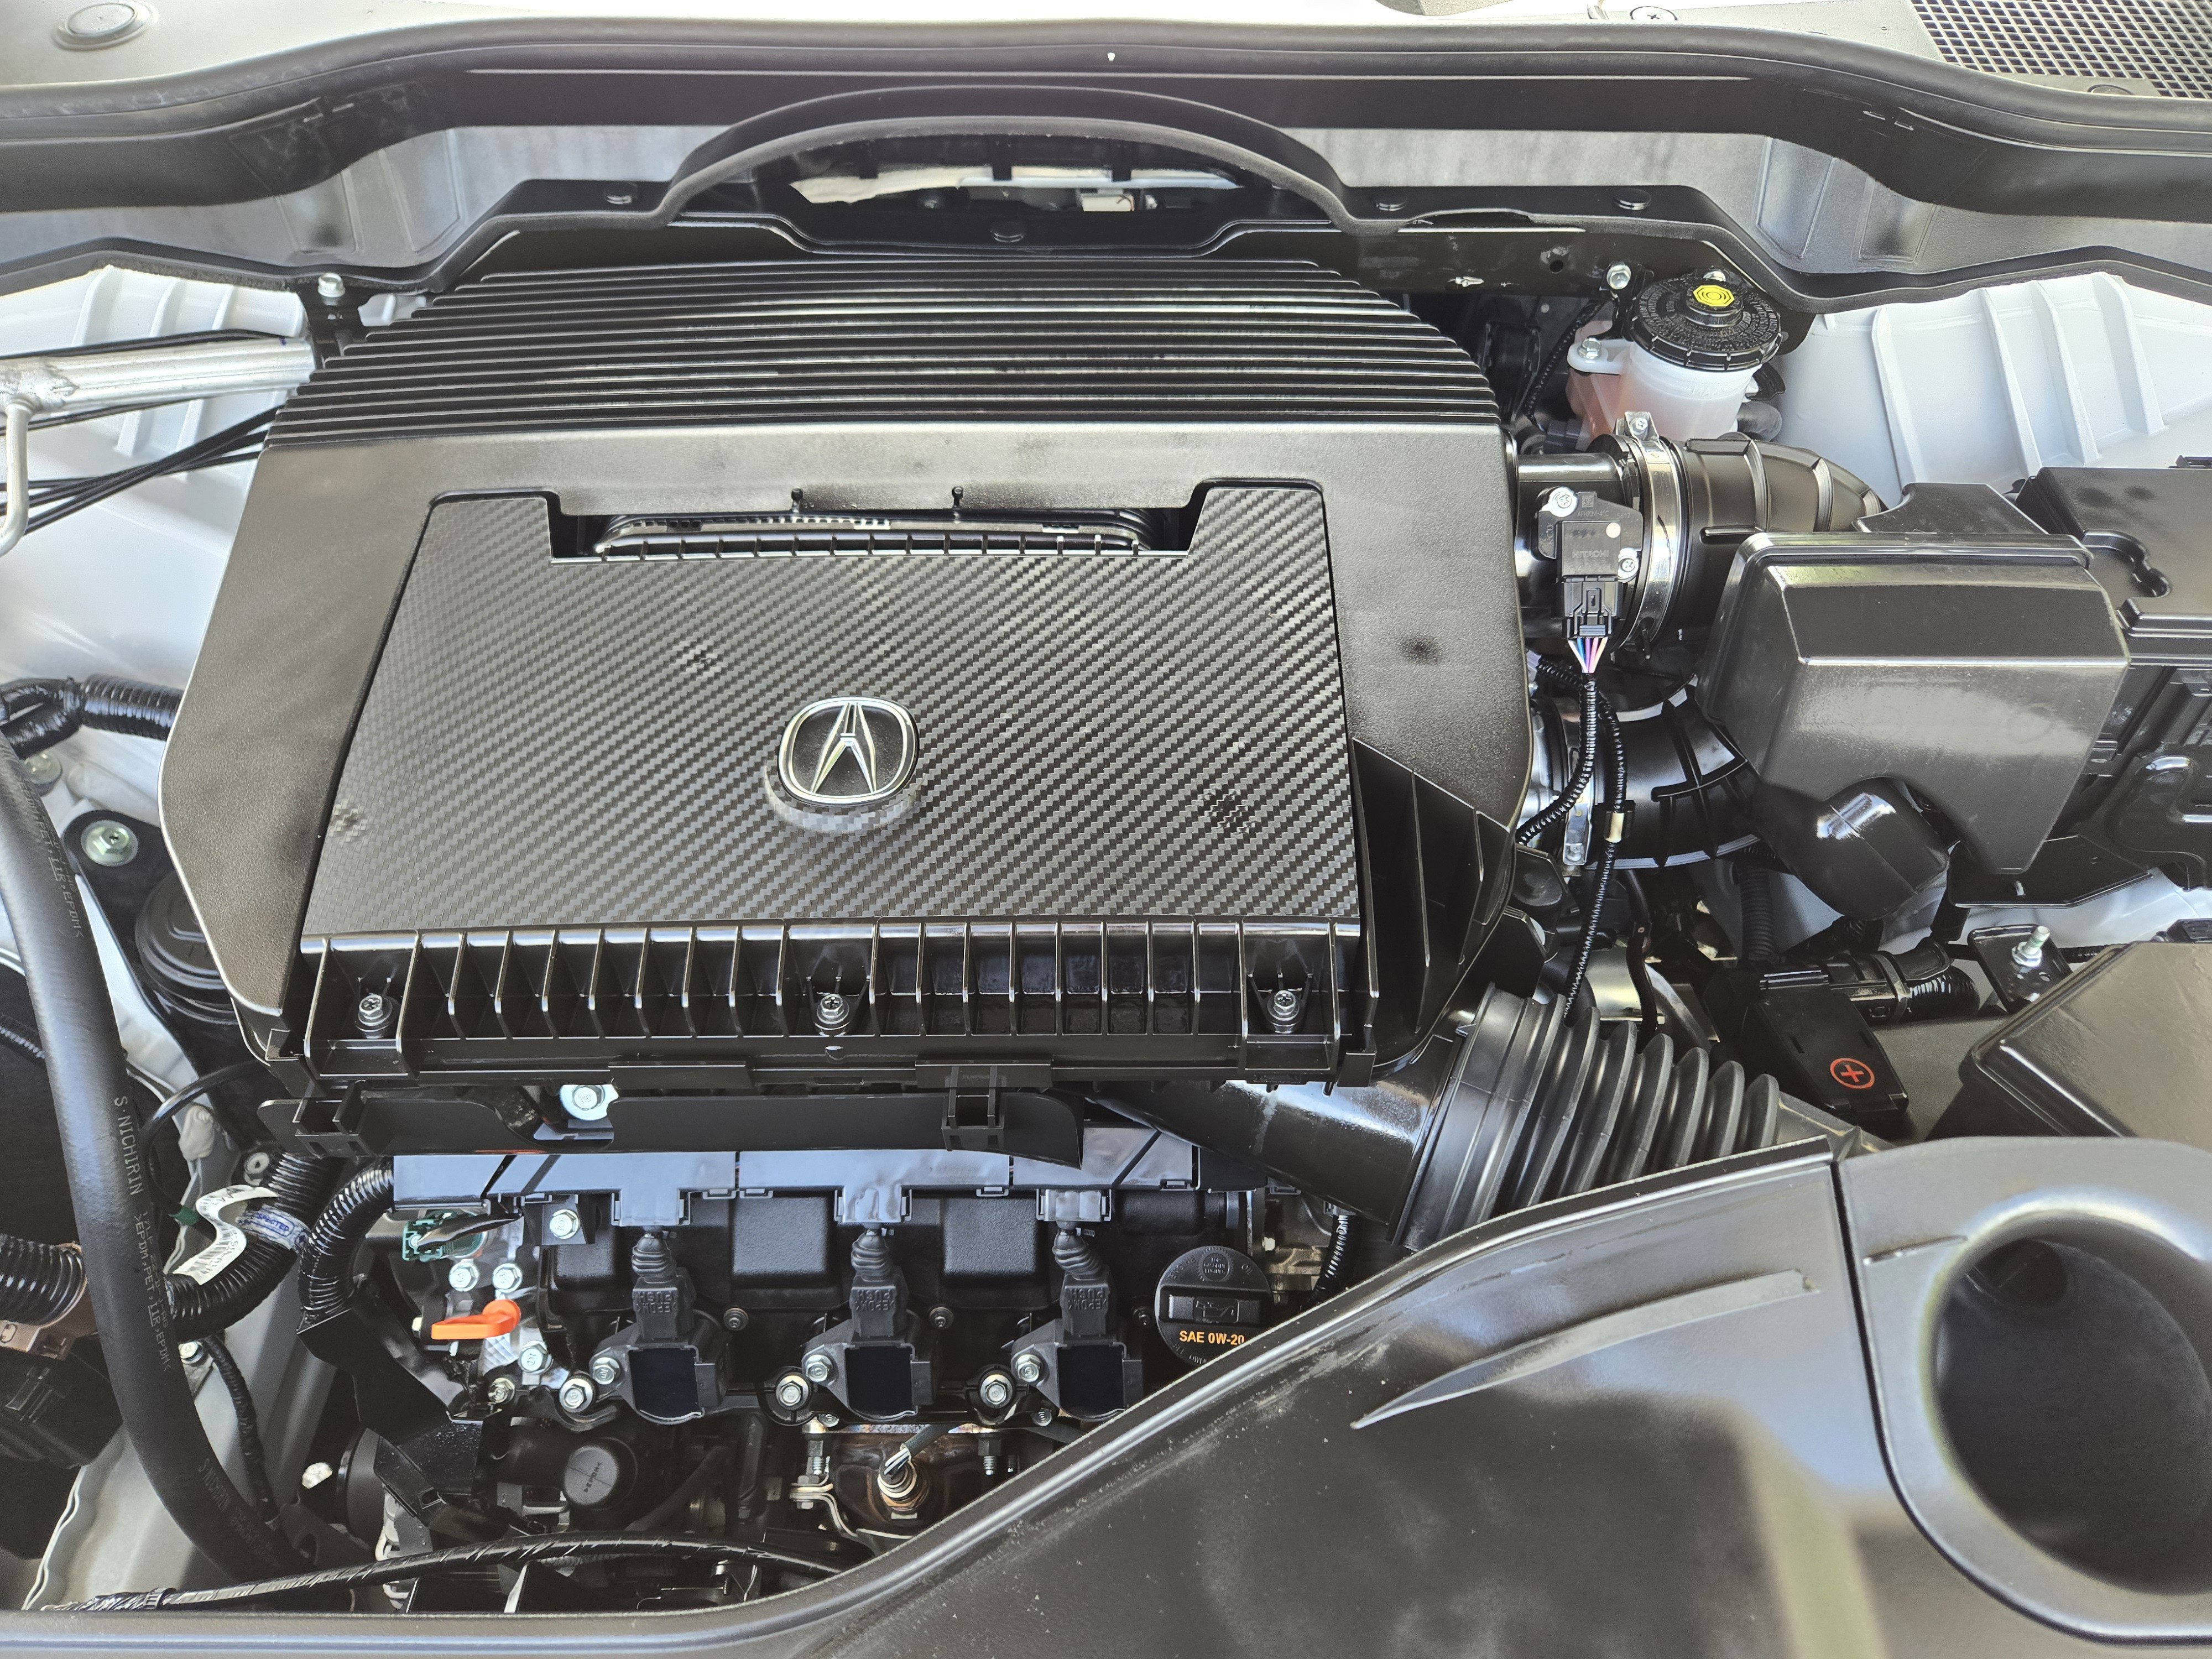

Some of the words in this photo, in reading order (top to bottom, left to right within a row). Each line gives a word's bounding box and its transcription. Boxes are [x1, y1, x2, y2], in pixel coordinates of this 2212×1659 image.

[1572, 550, 1609, 559] HITACHI
[1070, 1287, 1104, 1298] PUSH
[1179, 1330, 1205, 1343] SAE
[1208, 1332, 1245, 1345] 0W-20
